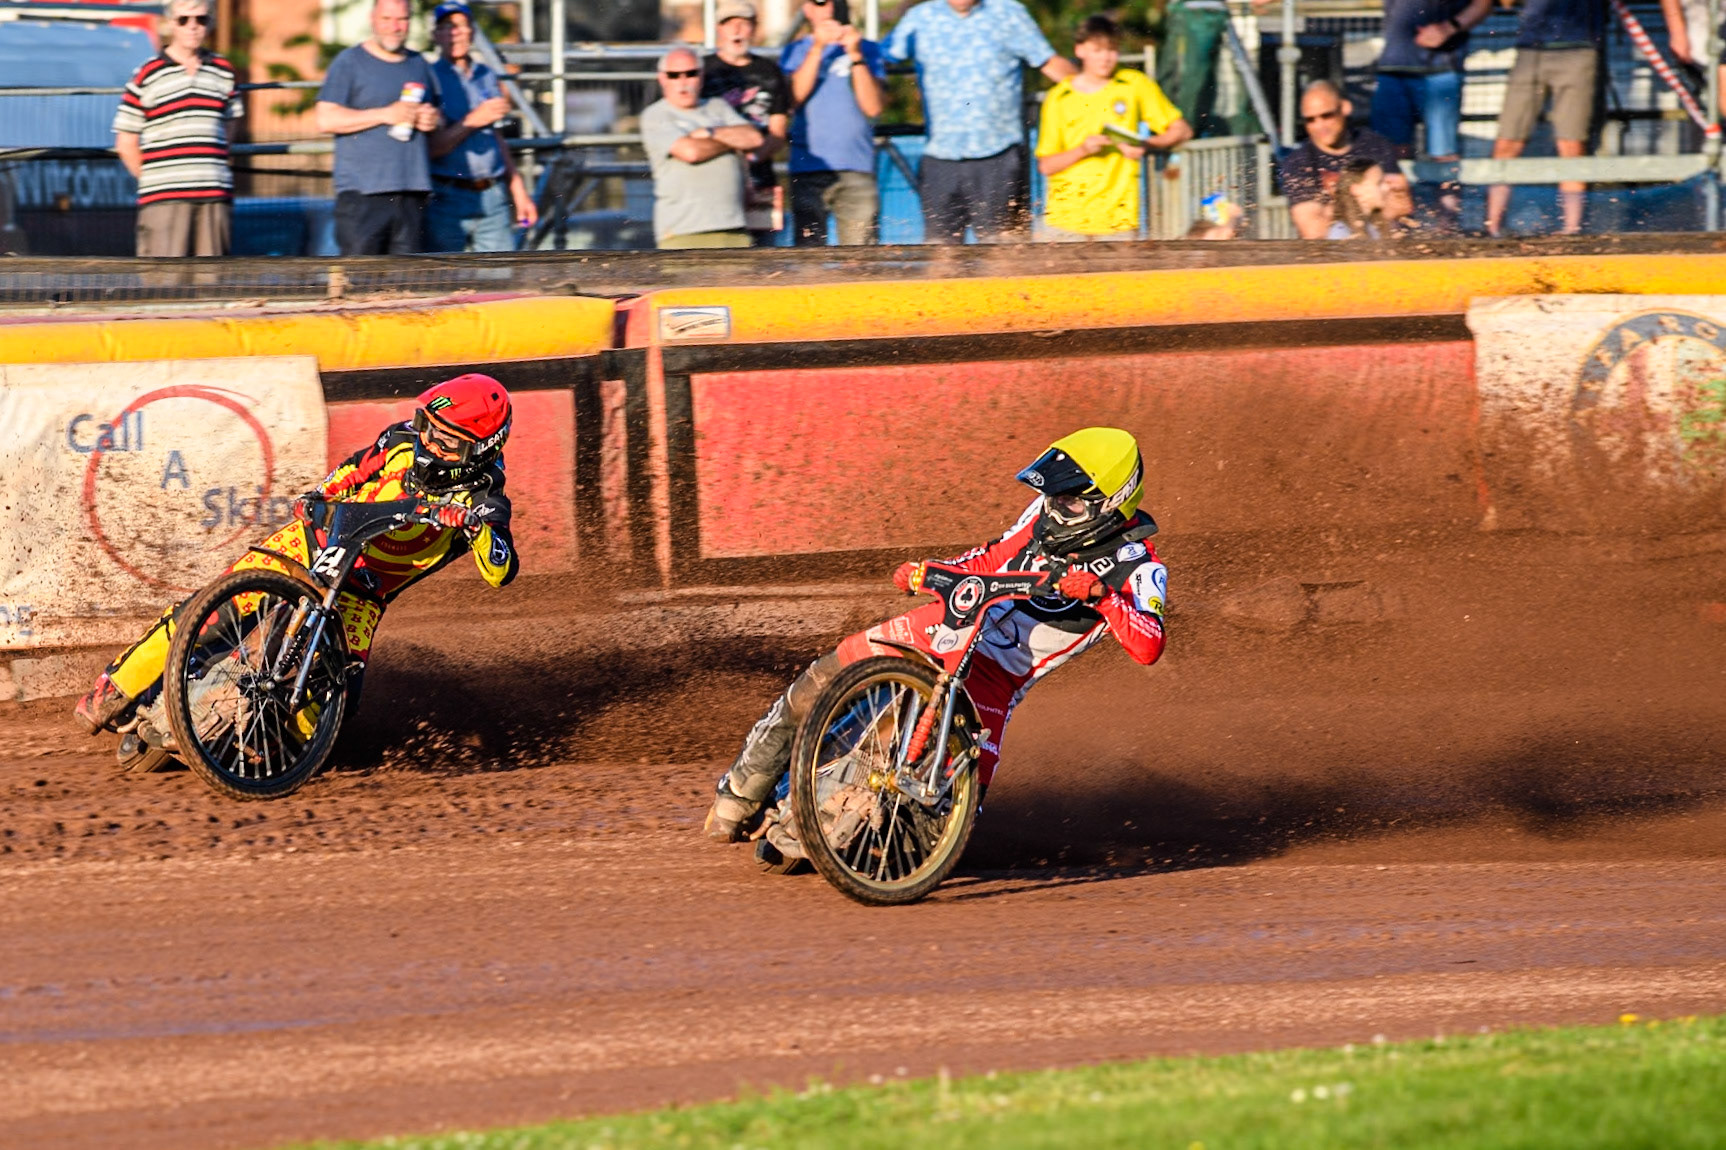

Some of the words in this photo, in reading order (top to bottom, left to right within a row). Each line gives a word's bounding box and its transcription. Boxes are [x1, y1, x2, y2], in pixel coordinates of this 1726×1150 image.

[68, 411, 143, 453] Call
[160, 450, 190, 489] A
[200, 484, 294, 534] Skip
